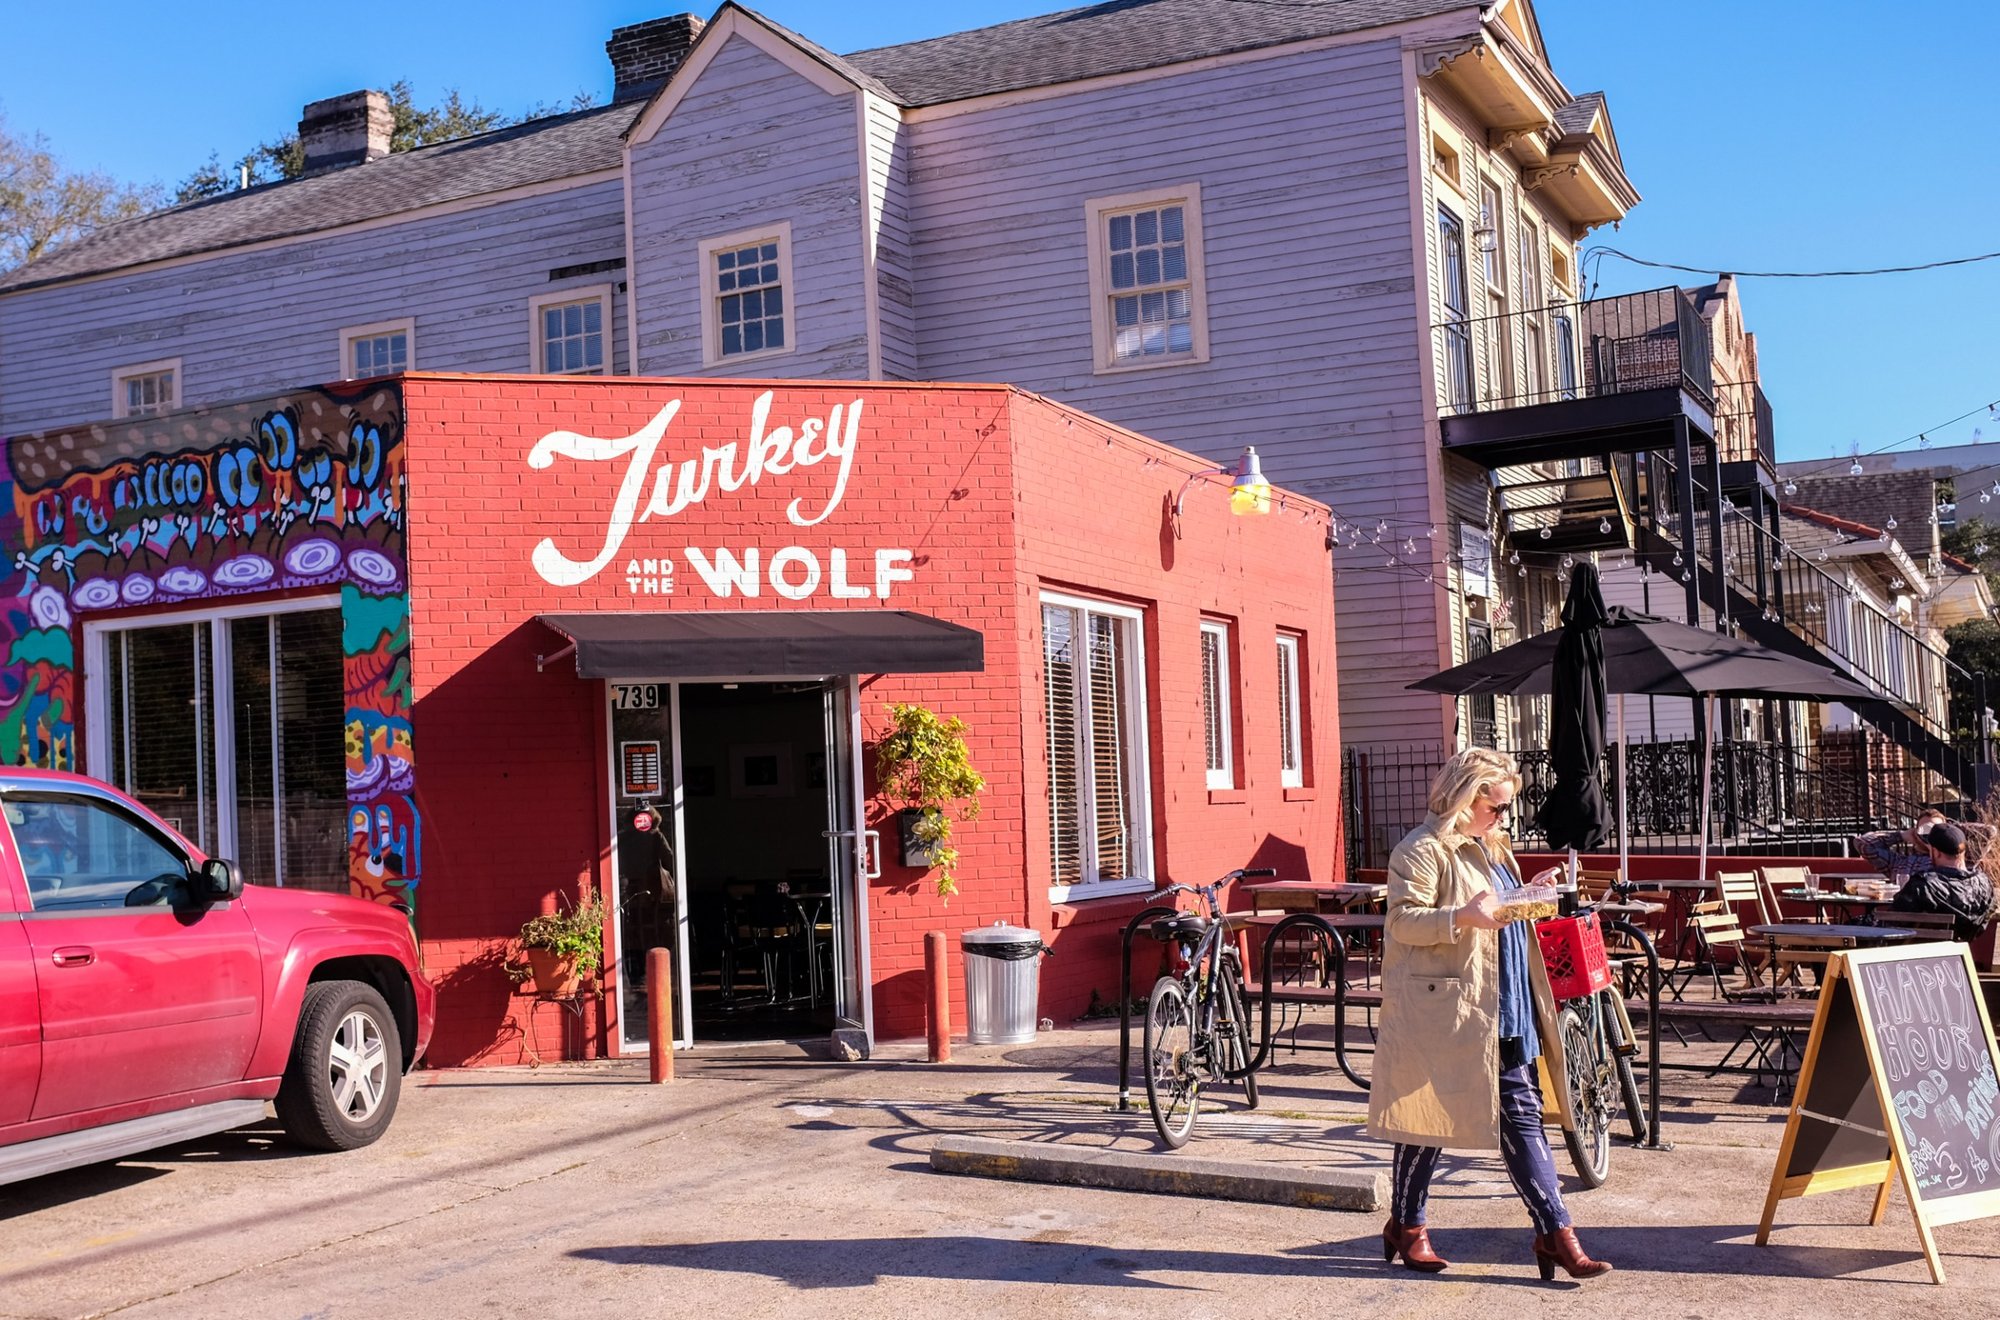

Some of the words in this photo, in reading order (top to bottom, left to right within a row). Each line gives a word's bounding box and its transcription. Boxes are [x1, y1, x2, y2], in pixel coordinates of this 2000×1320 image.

[527, 390, 864, 586] Turkey
[626, 577, 674, 594] THE
[627, 559, 674, 575] AND
[683, 546, 913, 600] WOLF
[618, 686, 657, 708] 739
[1866, 960, 1973, 1033] HAPPY
[1878, 1023, 1982, 1081] HOUR
[1892, 1069, 1948, 1147] FOOD
